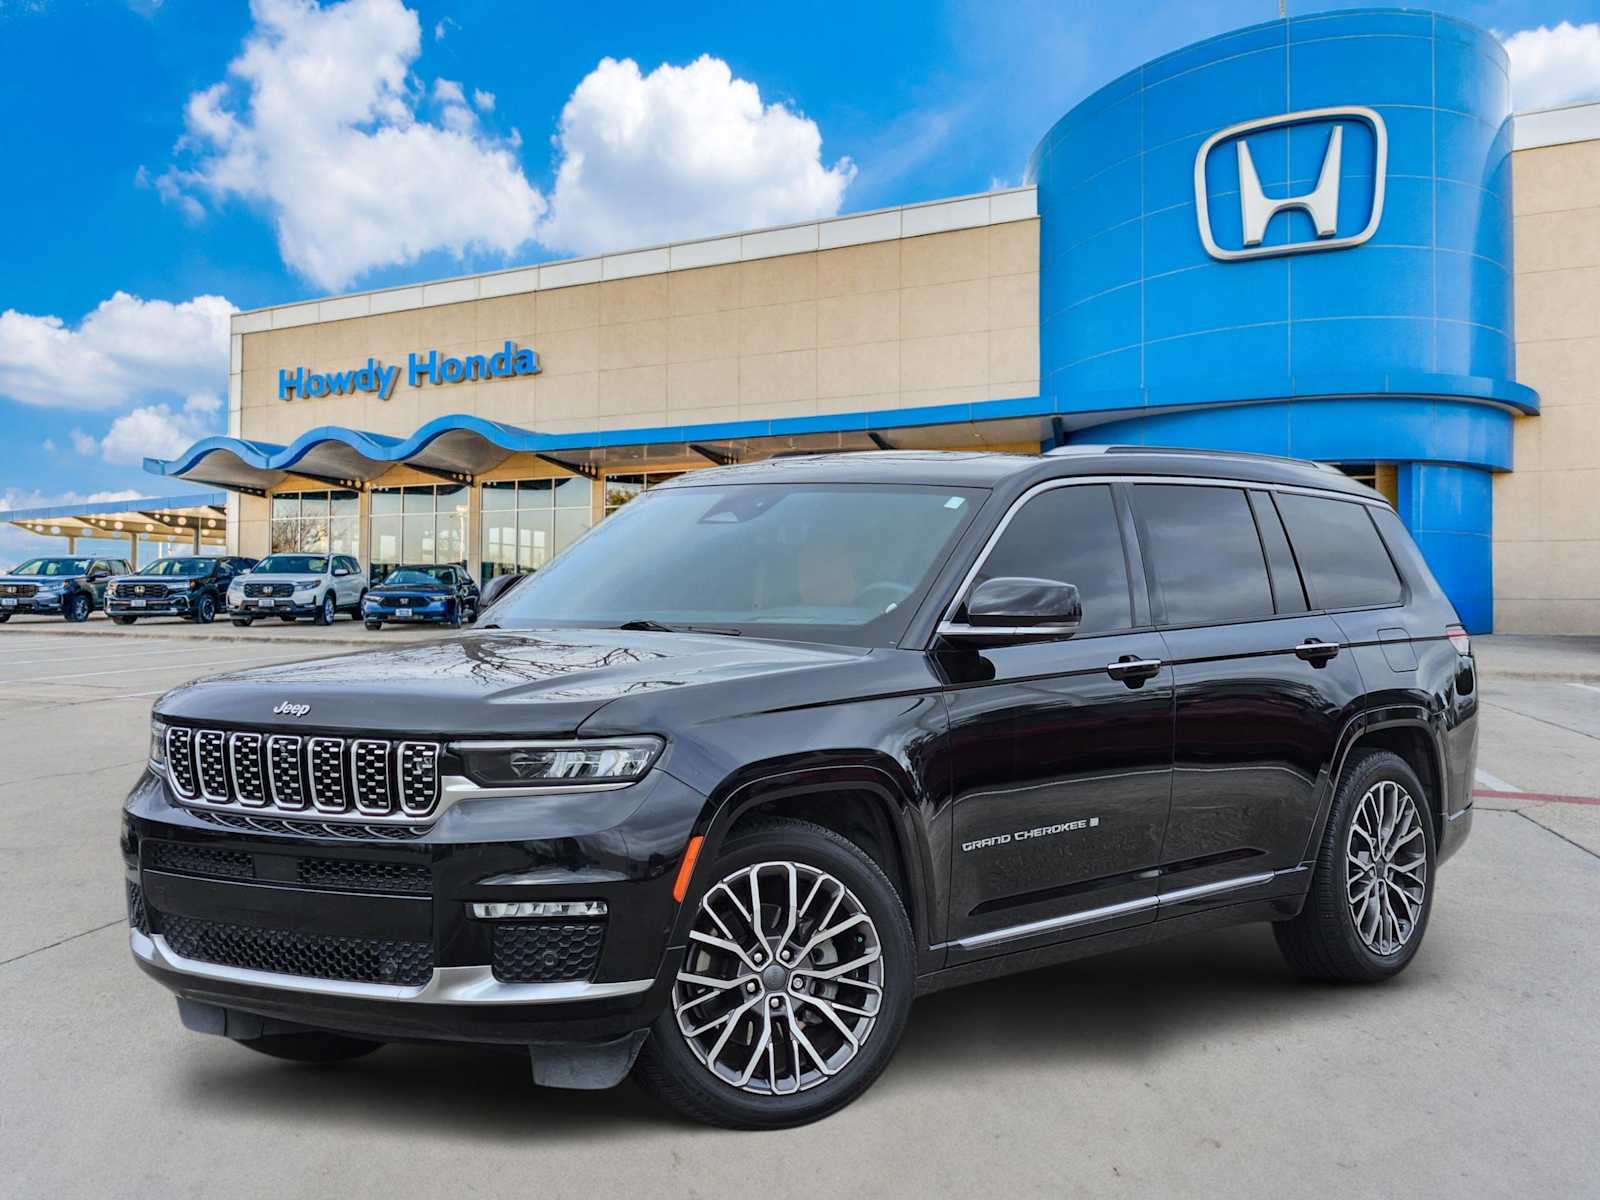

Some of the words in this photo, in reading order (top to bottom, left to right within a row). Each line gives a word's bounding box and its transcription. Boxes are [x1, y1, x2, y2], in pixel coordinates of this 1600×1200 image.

[278, 358, 401, 401] Howdy
[407, 340, 542, 388] Honda
[273, 700, 311, 717] Jeep
[961, 834, 1011, 852] GRAND
[1014, 819, 1088, 841] CHEROKEE
